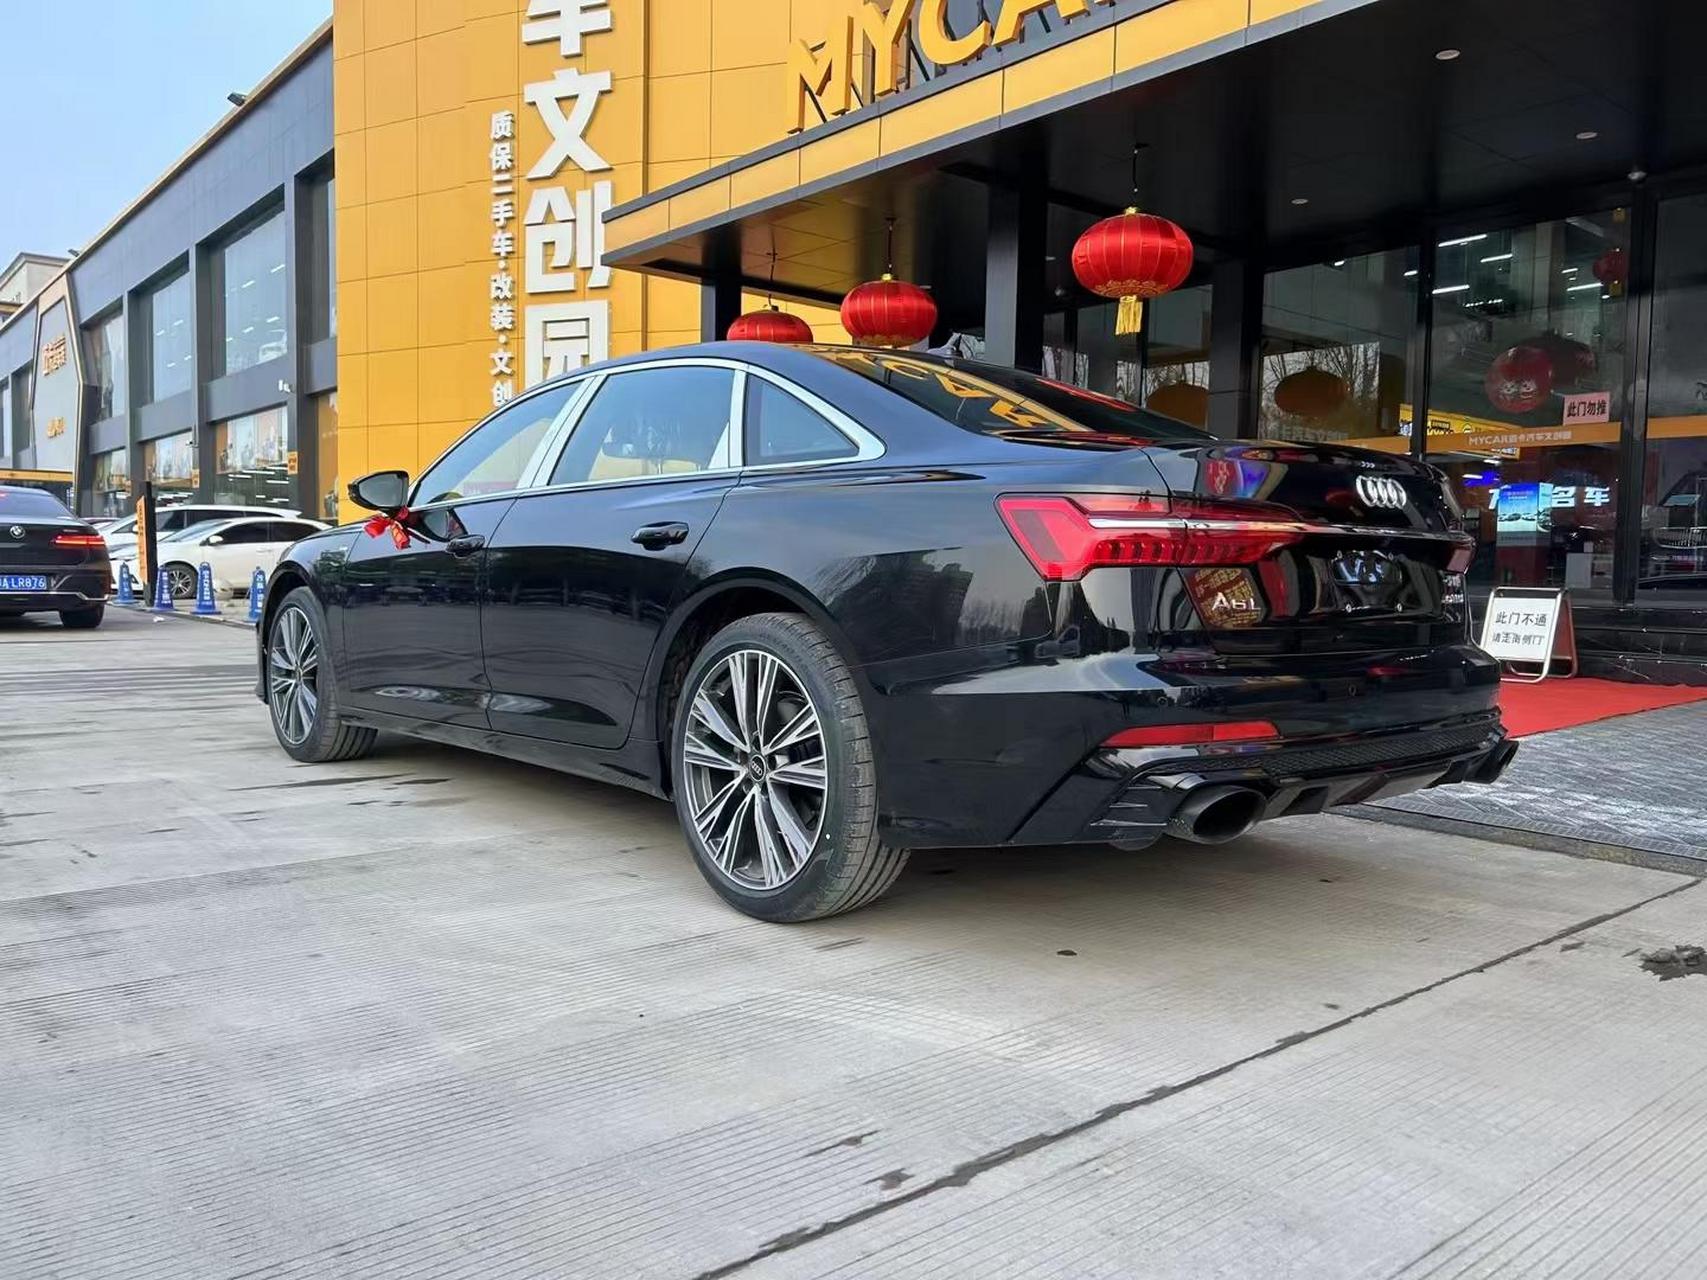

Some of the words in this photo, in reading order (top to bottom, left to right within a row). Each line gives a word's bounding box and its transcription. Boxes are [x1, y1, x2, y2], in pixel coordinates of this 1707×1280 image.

[1566, 400, 1607, 418] 此门勿推
[1212, 592, 1261, 611] A6L
[1495, 611, 1547, 627] 此门不通
